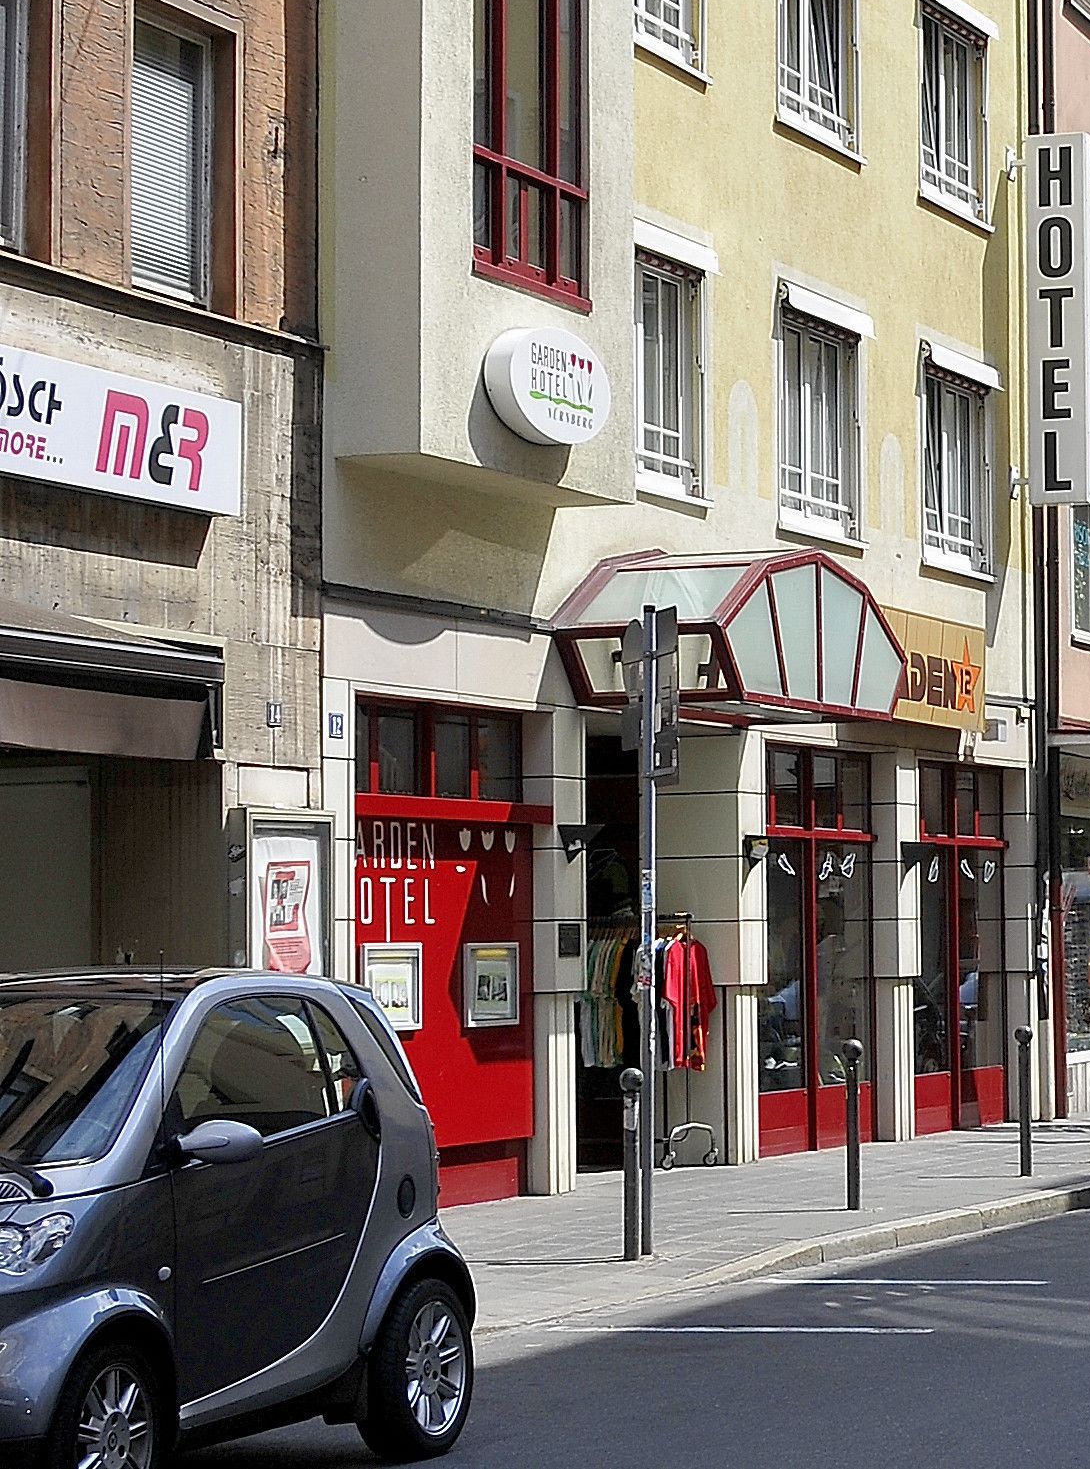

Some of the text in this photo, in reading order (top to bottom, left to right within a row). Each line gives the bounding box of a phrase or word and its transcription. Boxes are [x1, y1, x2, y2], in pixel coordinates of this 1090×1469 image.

[1038, 146, 1074, 492] HOTEL
[531, 342, 567, 373] GARDEN
[531, 368, 568, 401] HOTEL
[960, 667, 972, 695] 12
[269, 704, 281, 723] 14
[332, 715, 342, 735] 12
[356, 820, 435, 870] ARDEN
[359, 876, 436, 943] OTEL
